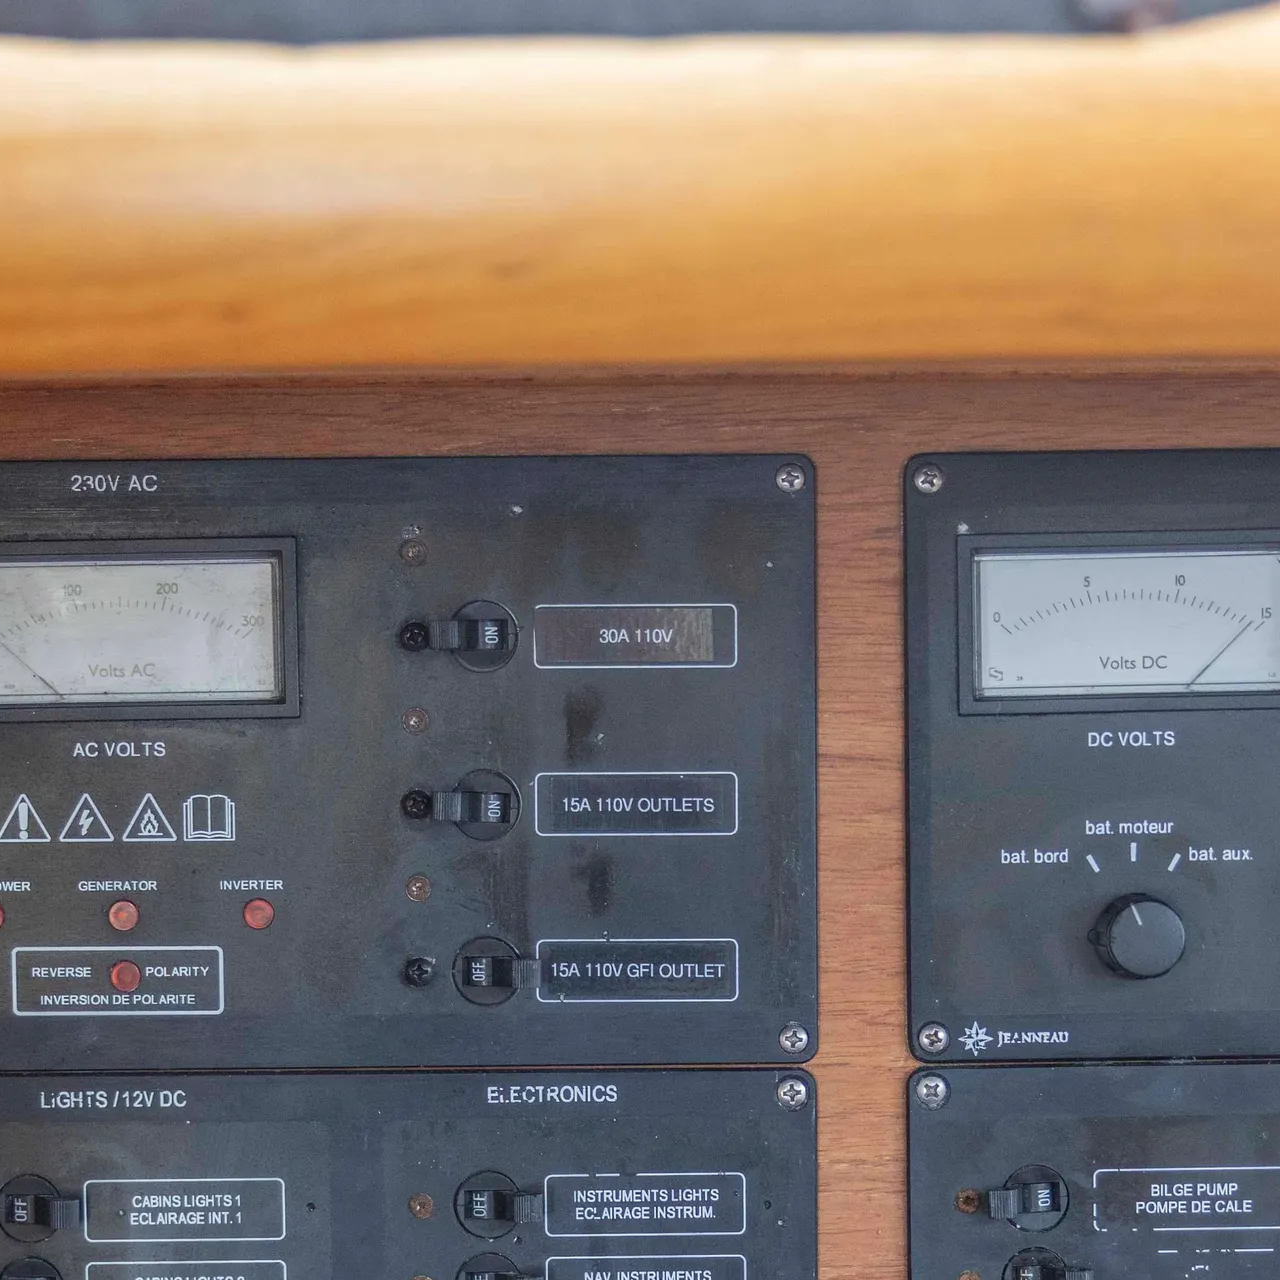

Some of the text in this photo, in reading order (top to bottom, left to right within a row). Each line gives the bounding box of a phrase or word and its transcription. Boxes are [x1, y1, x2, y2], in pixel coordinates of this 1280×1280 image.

[71, 475, 157, 491] 230V AC
[1084, 576, 1090, 587] 5
[1175, 575, 1185, 586] 10
[156, 583, 178, 595] 200
[1262, 607, 1272, 619] 15
[485, 626, 499, 644] ON
[600, 629, 673, 643] 30A 110V
[1099, 656, 1167, 669] Volts DC
[88, 663, 157, 679] Volts AC
[1088, 731, 1175, 746] DC VOLTS
[73, 742, 165, 757] AC VOLTS
[563, 798, 714, 812] 15A 110V OUTLETS
[1086, 820, 1174, 834] bat. moteur
[1002, 849, 1068, 863] bat. bord
[1189, 847, 1254, 860] bat. aux.
[78, 881, 157, 891] GENERATOR
[220, 880, 283, 890] INVERTER
[32, 967, 209, 977] REVERSE POLARITY
[473, 962, 485, 981] OFF
[552, 963, 725, 977] 15A 110V GFI OUTLET
[41, 995, 195, 1005] INVERSION DE POLARITE
[998, 1031, 1068, 1047] JEANNEAU
[574, 1189, 719, 1202] INSTRUMENTS LIGHTS
[1151, 1183, 1237, 1196] BILGE PUMP
[132, 1195, 240, 1207] CABINS LIGHTS 1
[1038, 1189, 1051, 1207] ON
[15, 1198, 28, 1222] OFF
[1136, 1200, 1252, 1213] POMPE DE CALE
[130, 1212, 241, 1225] ECLAIRAGE INT. 1
